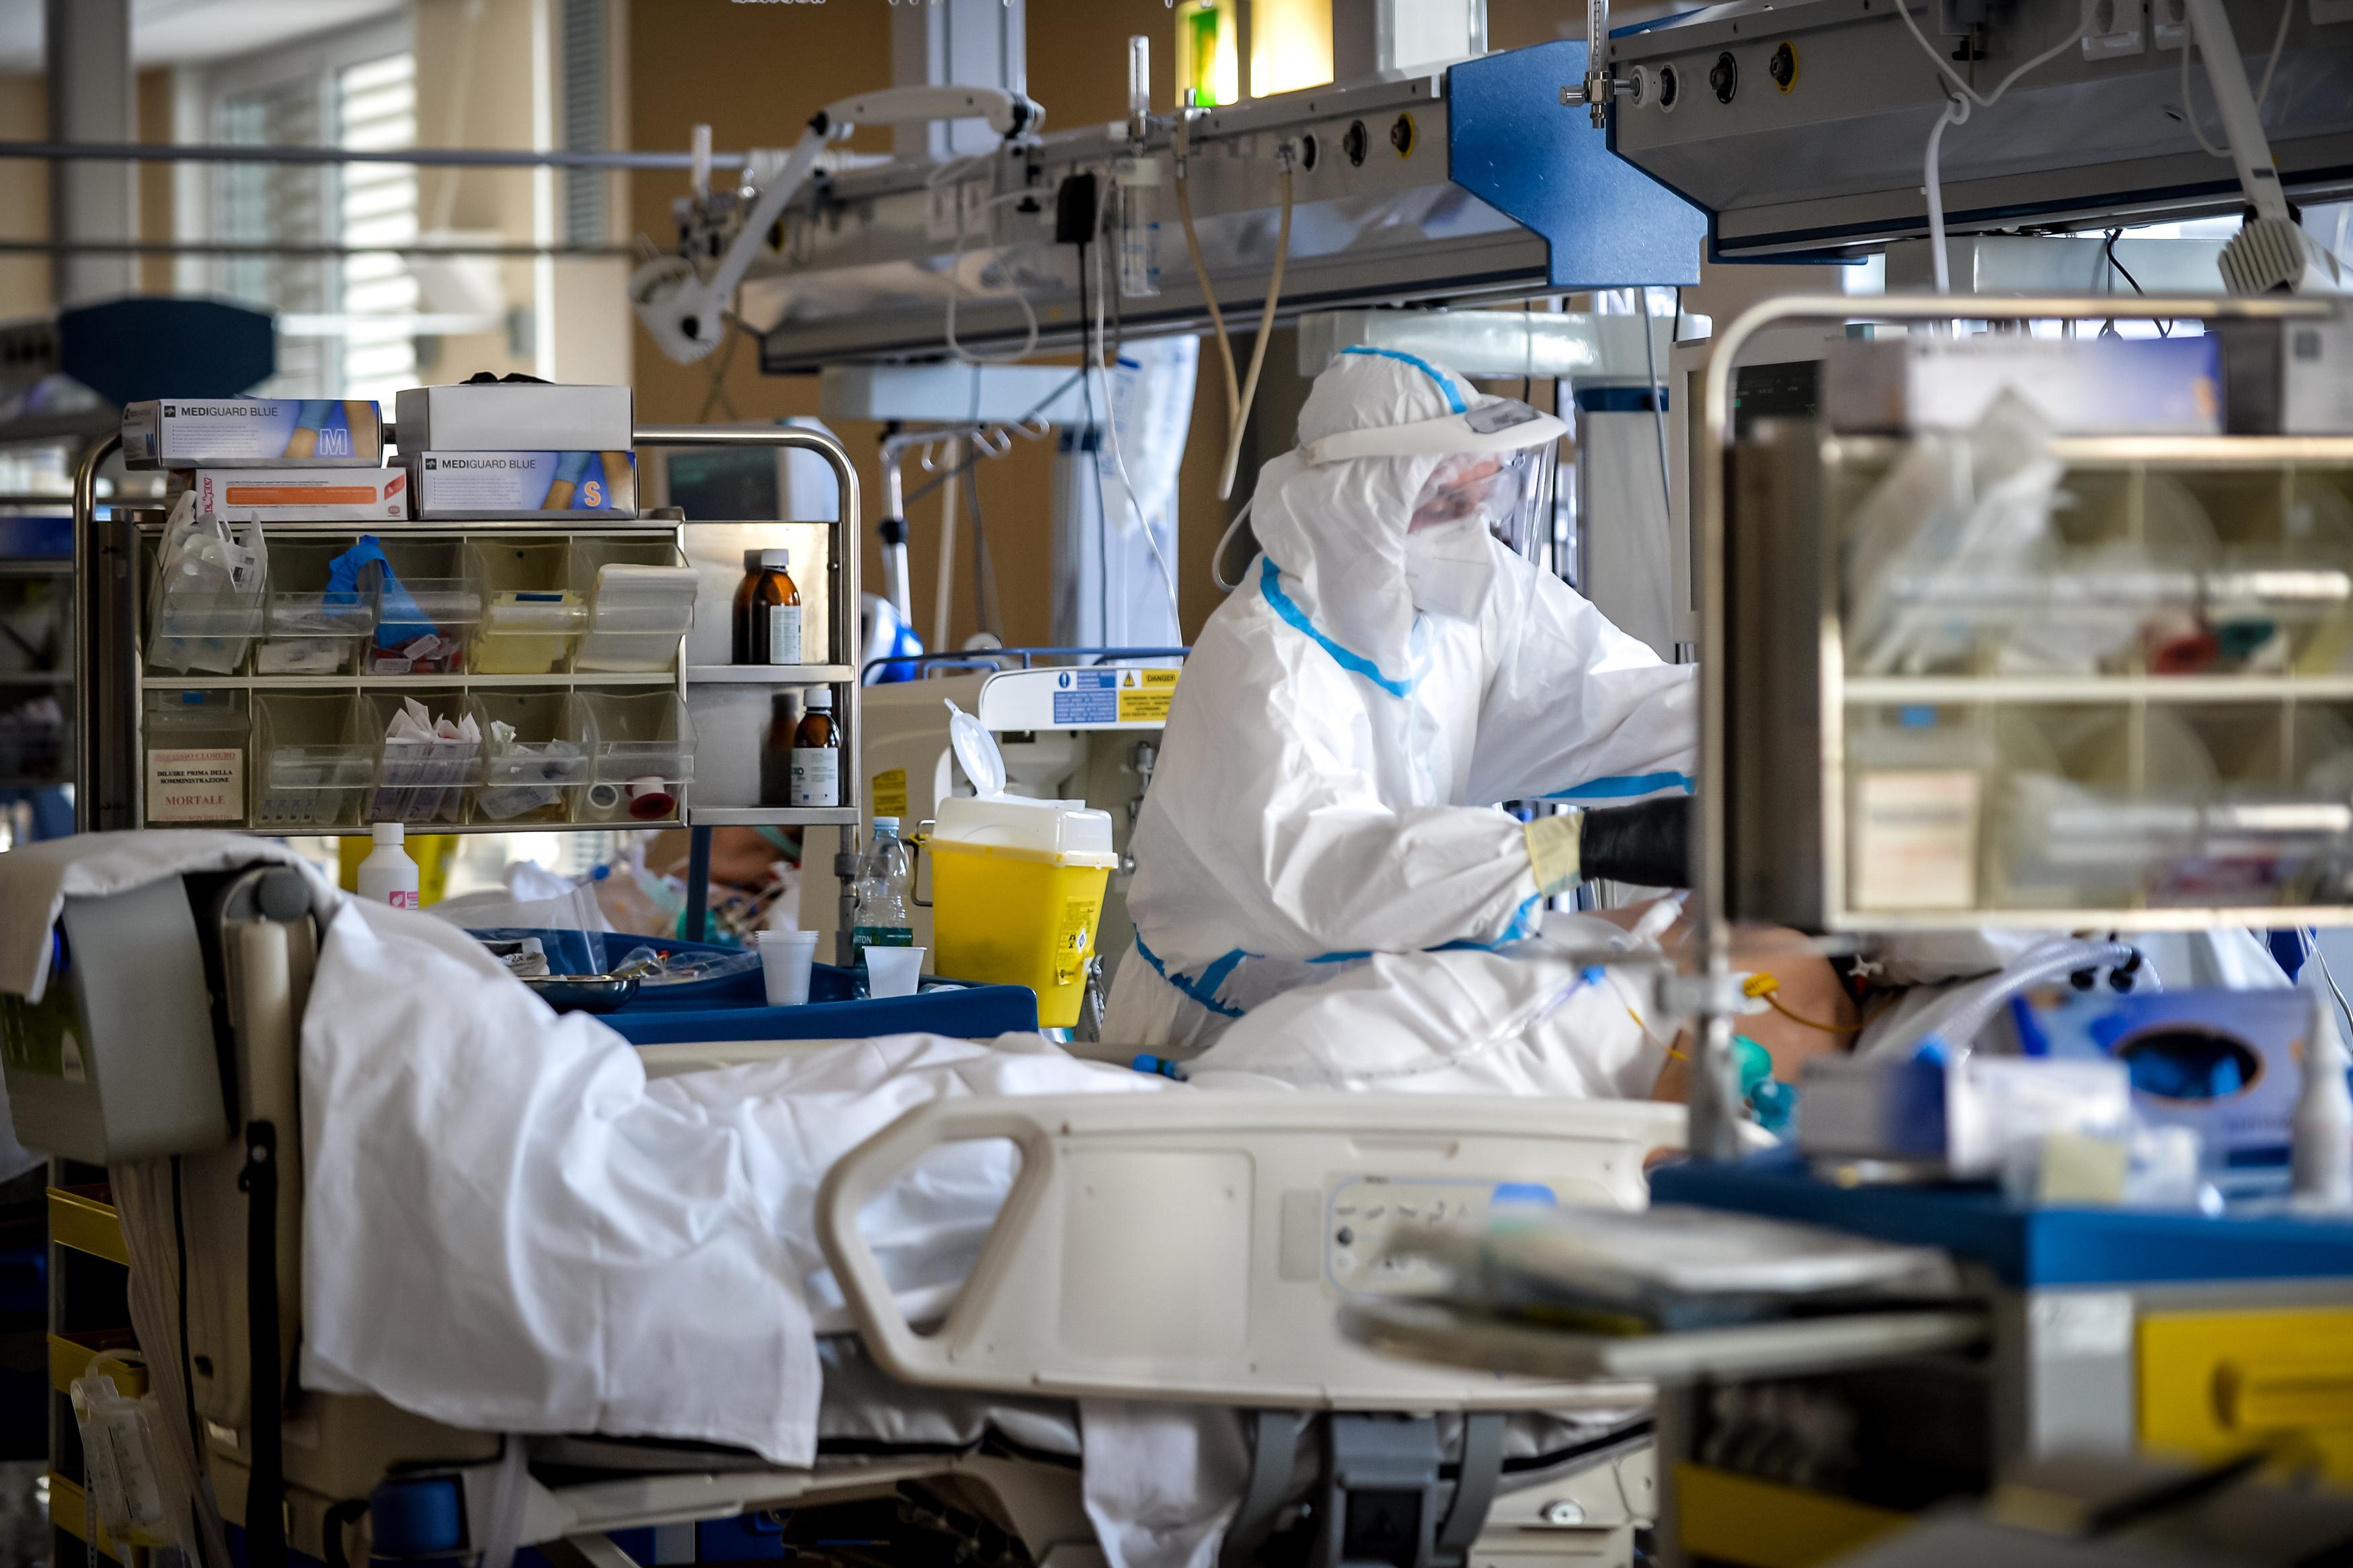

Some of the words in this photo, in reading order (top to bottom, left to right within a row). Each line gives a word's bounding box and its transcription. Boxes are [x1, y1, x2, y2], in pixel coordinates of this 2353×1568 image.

[181, 407, 247, 417] MEDIGUARD
[249, 407, 278, 417] BLUE
[319, 429, 348, 454] M
[442, 460, 507, 469] MEDIGUARD
[509, 460, 536, 469] BLUE
[584, 481, 601, 507] S
[165, 795, 225, 805] MORTALE
